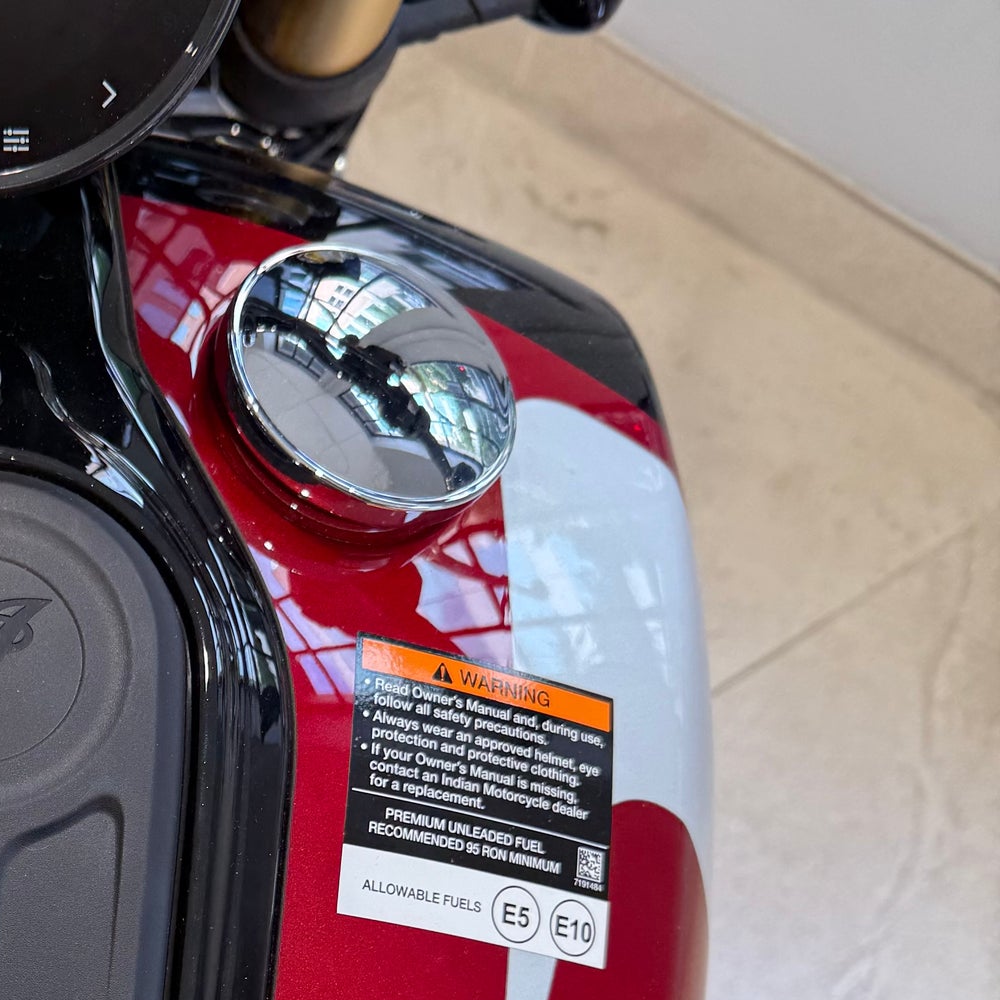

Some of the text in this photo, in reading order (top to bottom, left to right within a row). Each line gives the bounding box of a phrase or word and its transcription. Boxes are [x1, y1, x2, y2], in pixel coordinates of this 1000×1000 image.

[459, 669, 550, 708] WARNING
[373, 692, 549, 745] follow all safety precautions.
[375, 677, 606, 749] Read Owner's Manual and, during use,
[371, 727, 582, 788] protection and protective clothing.
[371, 742, 381, 755] If
[383, 748, 413, 762] your
[415, 752, 467, 775] Owner's
[469, 764, 516, 786] Manual
[516, 776, 529, 789] is
[372, 710, 601, 777] Always wear an approved helmet, eye
[369, 760, 590, 820] contact an Indian Motorcycle dealer
[369, 773, 486, 810] for a replacement.
[368, 821, 562, 875] RECOMMENDED 95 RON MINIMUM
[385, 807, 547, 855] PREMIUM UNLEADED FUEL
[362, 879, 482, 913] ALLOWABLE FUELS
[502, 902, 530, 928] E5
[554, 914, 592, 943] E10
